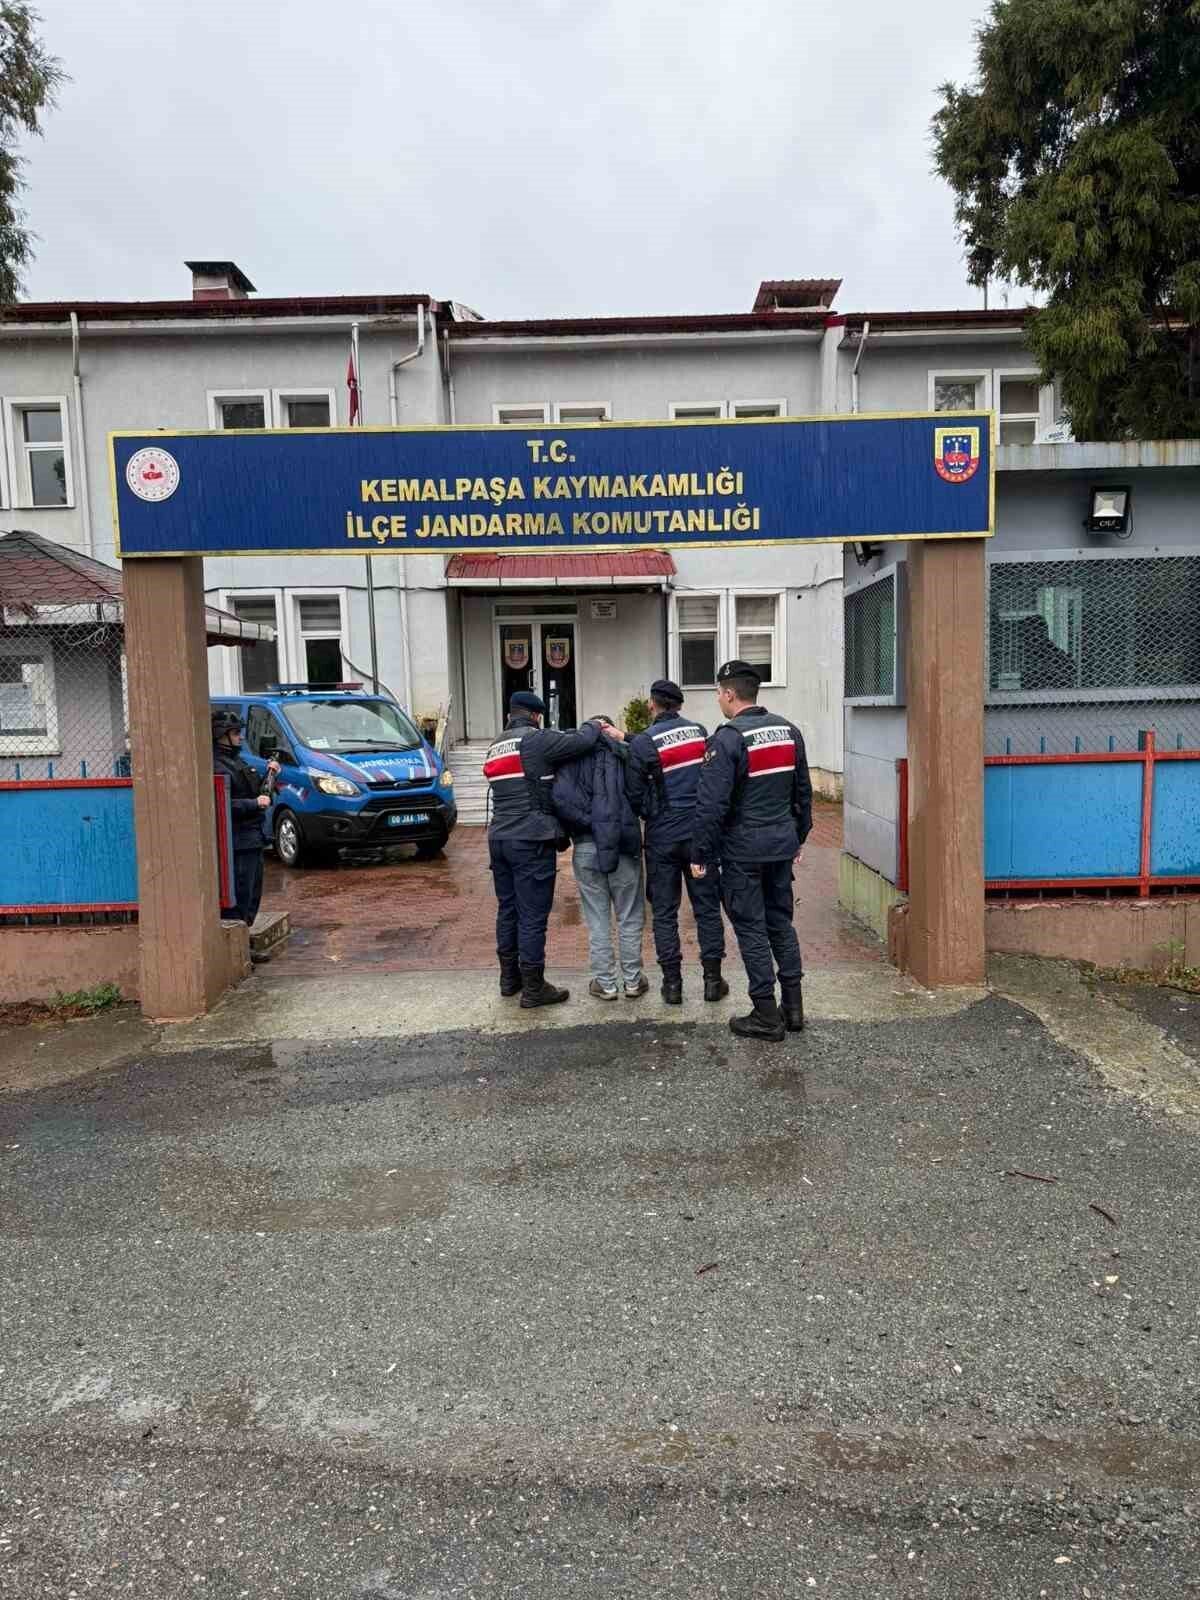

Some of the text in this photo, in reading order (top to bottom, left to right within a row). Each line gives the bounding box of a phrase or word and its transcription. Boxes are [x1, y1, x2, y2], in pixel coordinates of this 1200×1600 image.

[526, 440, 576, 463] T.C.
[361, 466, 743, 506] KEMALPAŞA KAYMAKAMLIĞI
[346, 502, 760, 544] İLÇE JANDARMA KOMUTANLIĞI
[359, 758, 423, 769] JANDARMA
